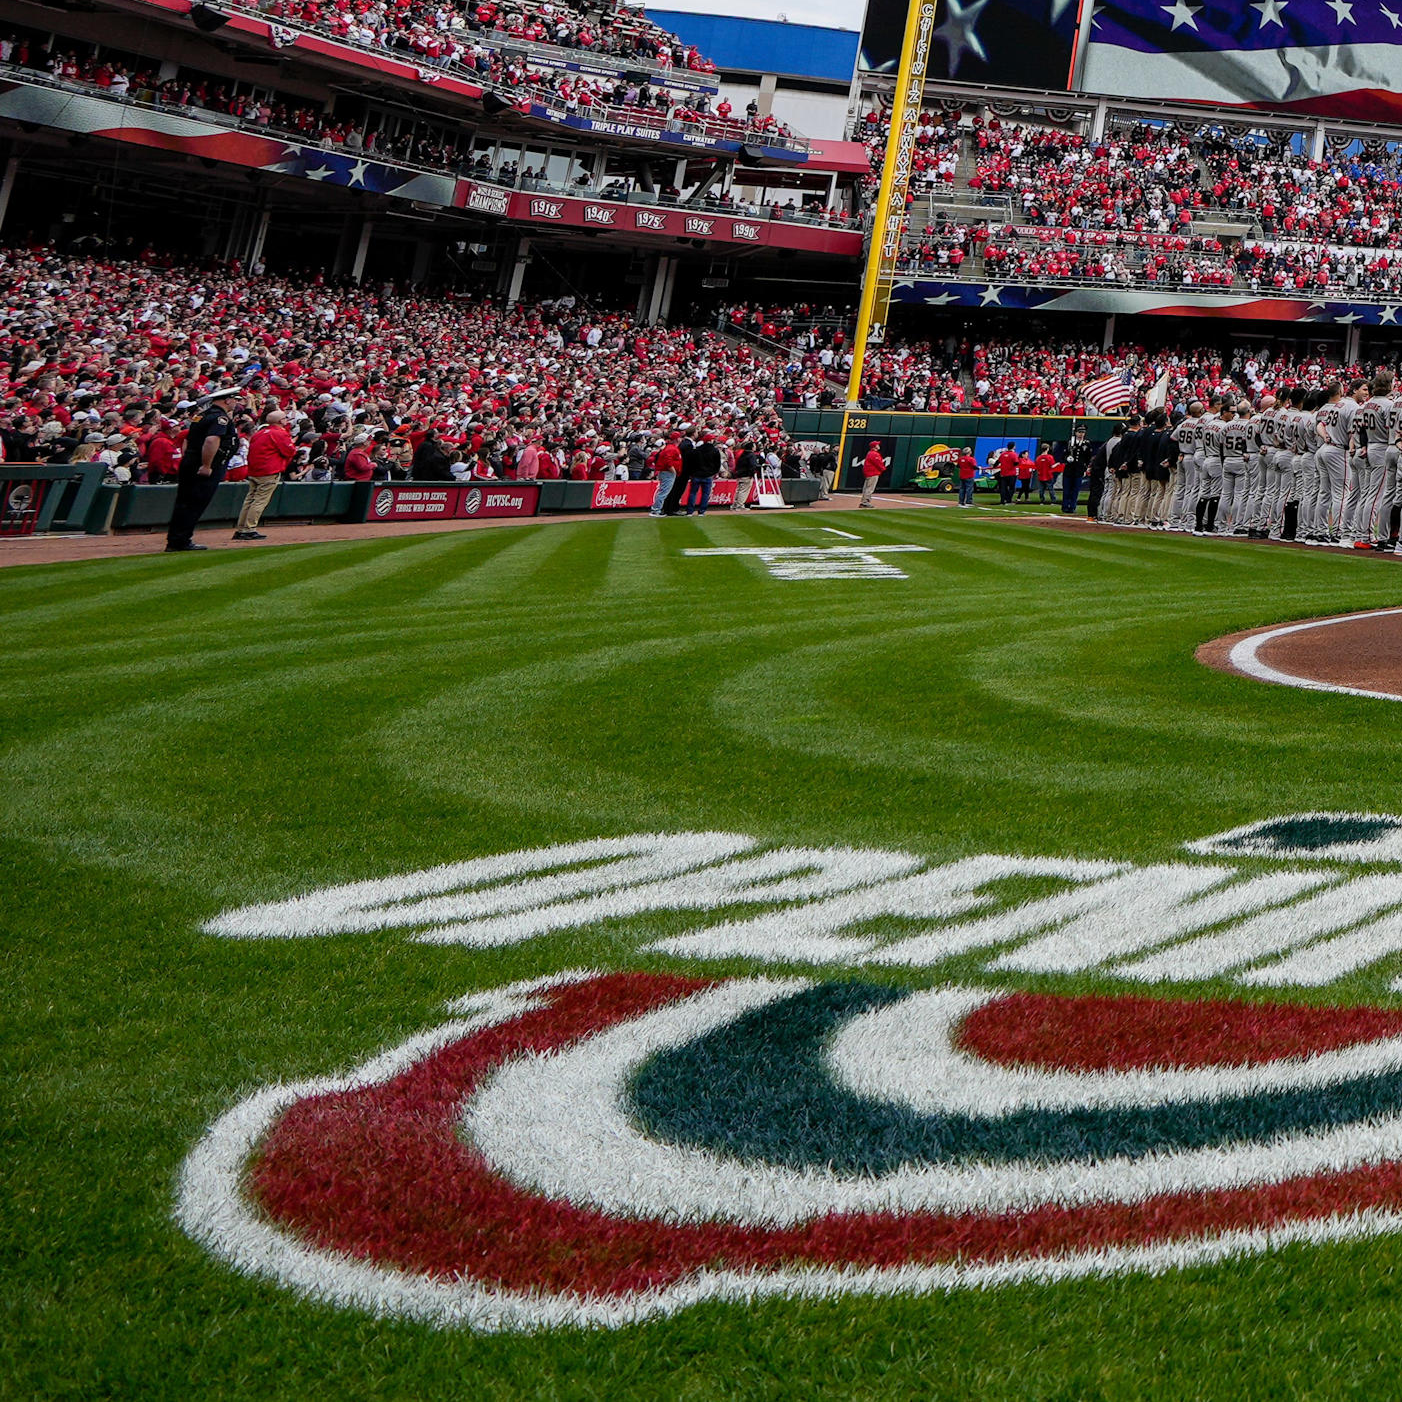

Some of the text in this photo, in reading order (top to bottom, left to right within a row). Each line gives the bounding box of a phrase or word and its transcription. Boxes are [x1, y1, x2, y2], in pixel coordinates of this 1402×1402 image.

[591, 120, 661, 140] TRIPLE PLAY SUITES
[533, 201, 557, 216] 1919
[587, 207, 610, 222] 1940
[638, 212, 660, 228] 1975
[687, 219, 709, 233] 1976
[735, 224, 755, 238] 1990
[847, 417, 867, 429] 328
[1261, 419, 1275, 435] 76
[1179, 430, 1193, 444] 96
[1205, 432, 1215, 447] 91
[1225, 435, 1243, 450] 52
[919, 450, 960, 469] Kahn's
[425, 503, 445, 512] SERVED
[486, 494, 524, 510] HCVSC.org
